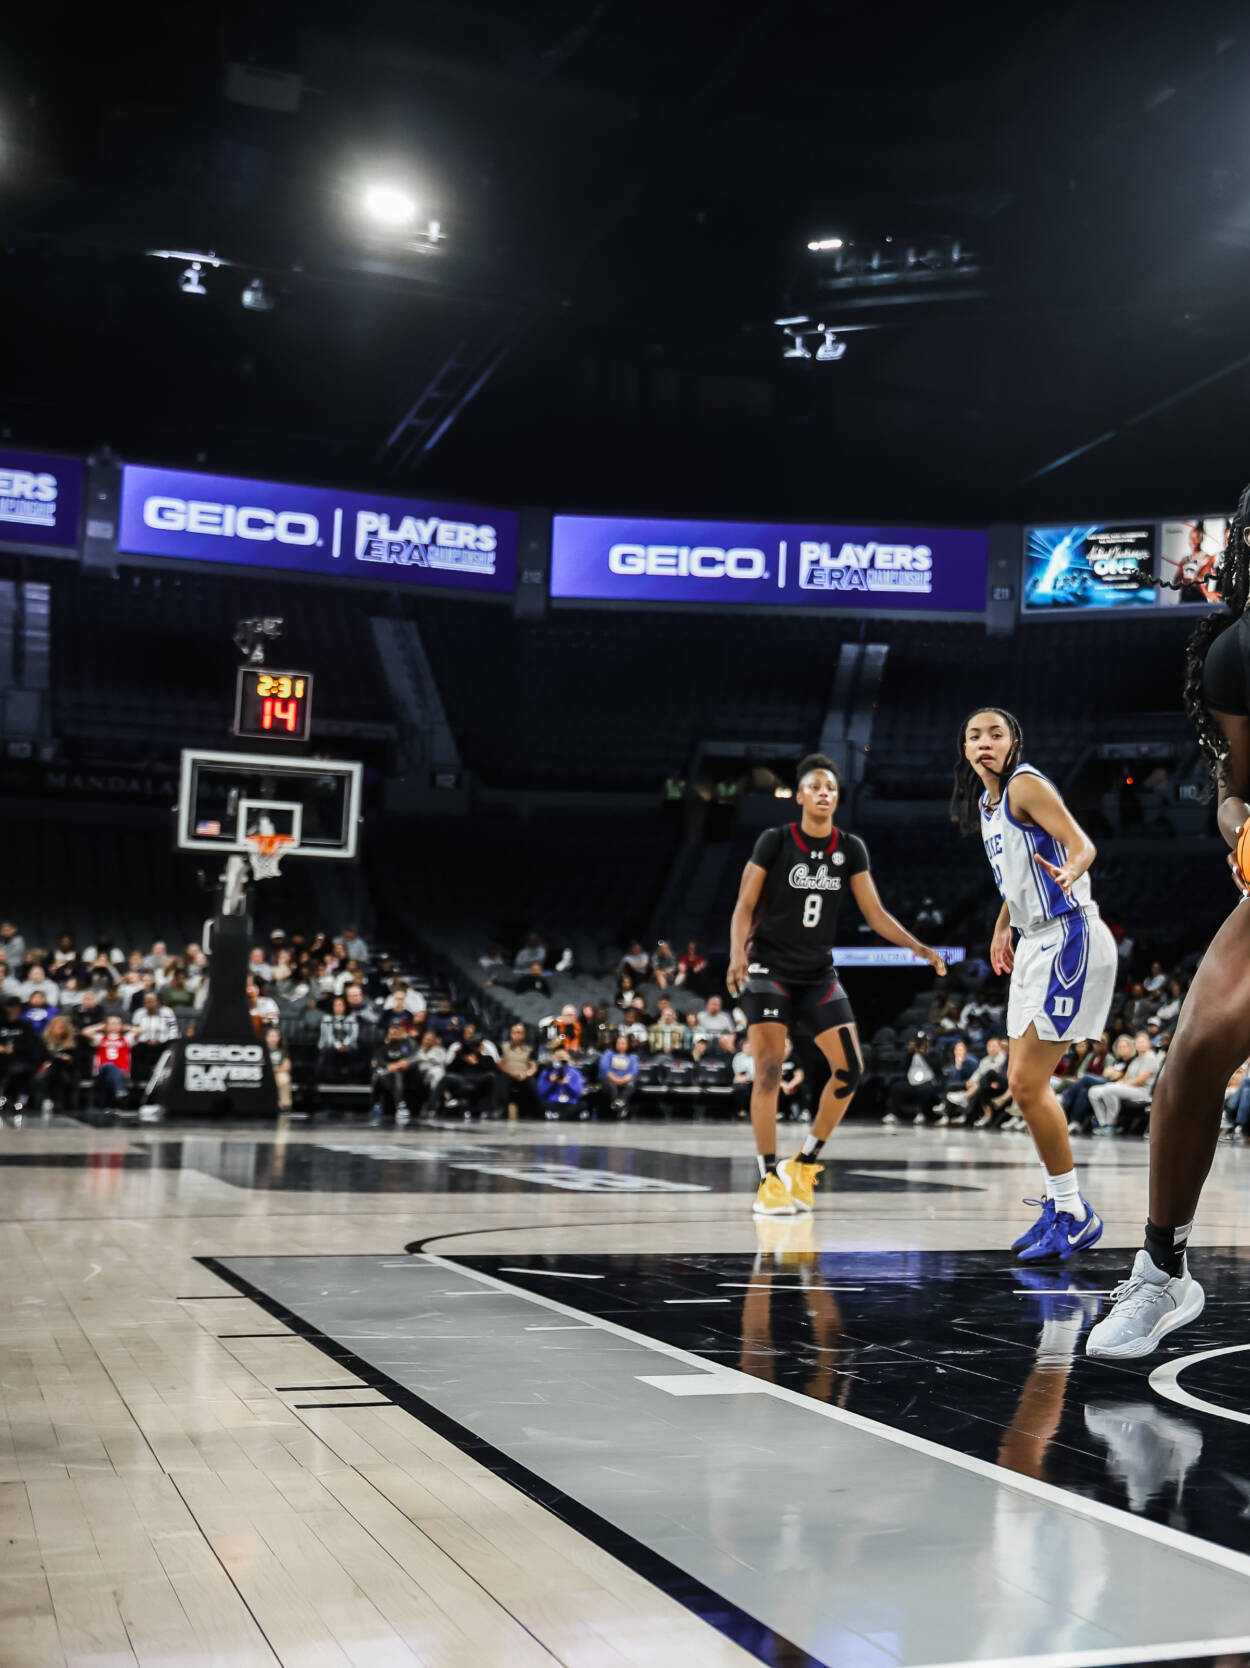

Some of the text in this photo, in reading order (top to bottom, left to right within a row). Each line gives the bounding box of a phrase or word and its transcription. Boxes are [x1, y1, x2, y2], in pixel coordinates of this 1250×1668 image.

[143, 496, 498, 552] GEICO PLAYERS
[362, 537, 432, 568] ERA
[608, 541, 932, 579] GEICO PLAYERS
[803, 566, 868, 591] ERA
[257, 674, 304, 699] 2:31
[262, 697, 298, 732] 14
[788, 863, 841, 891] Carolina
[802, 893, 823, 929] 8
[1051, 995, 1074, 1017] D
[185, 1044, 264, 1062] GEICO
